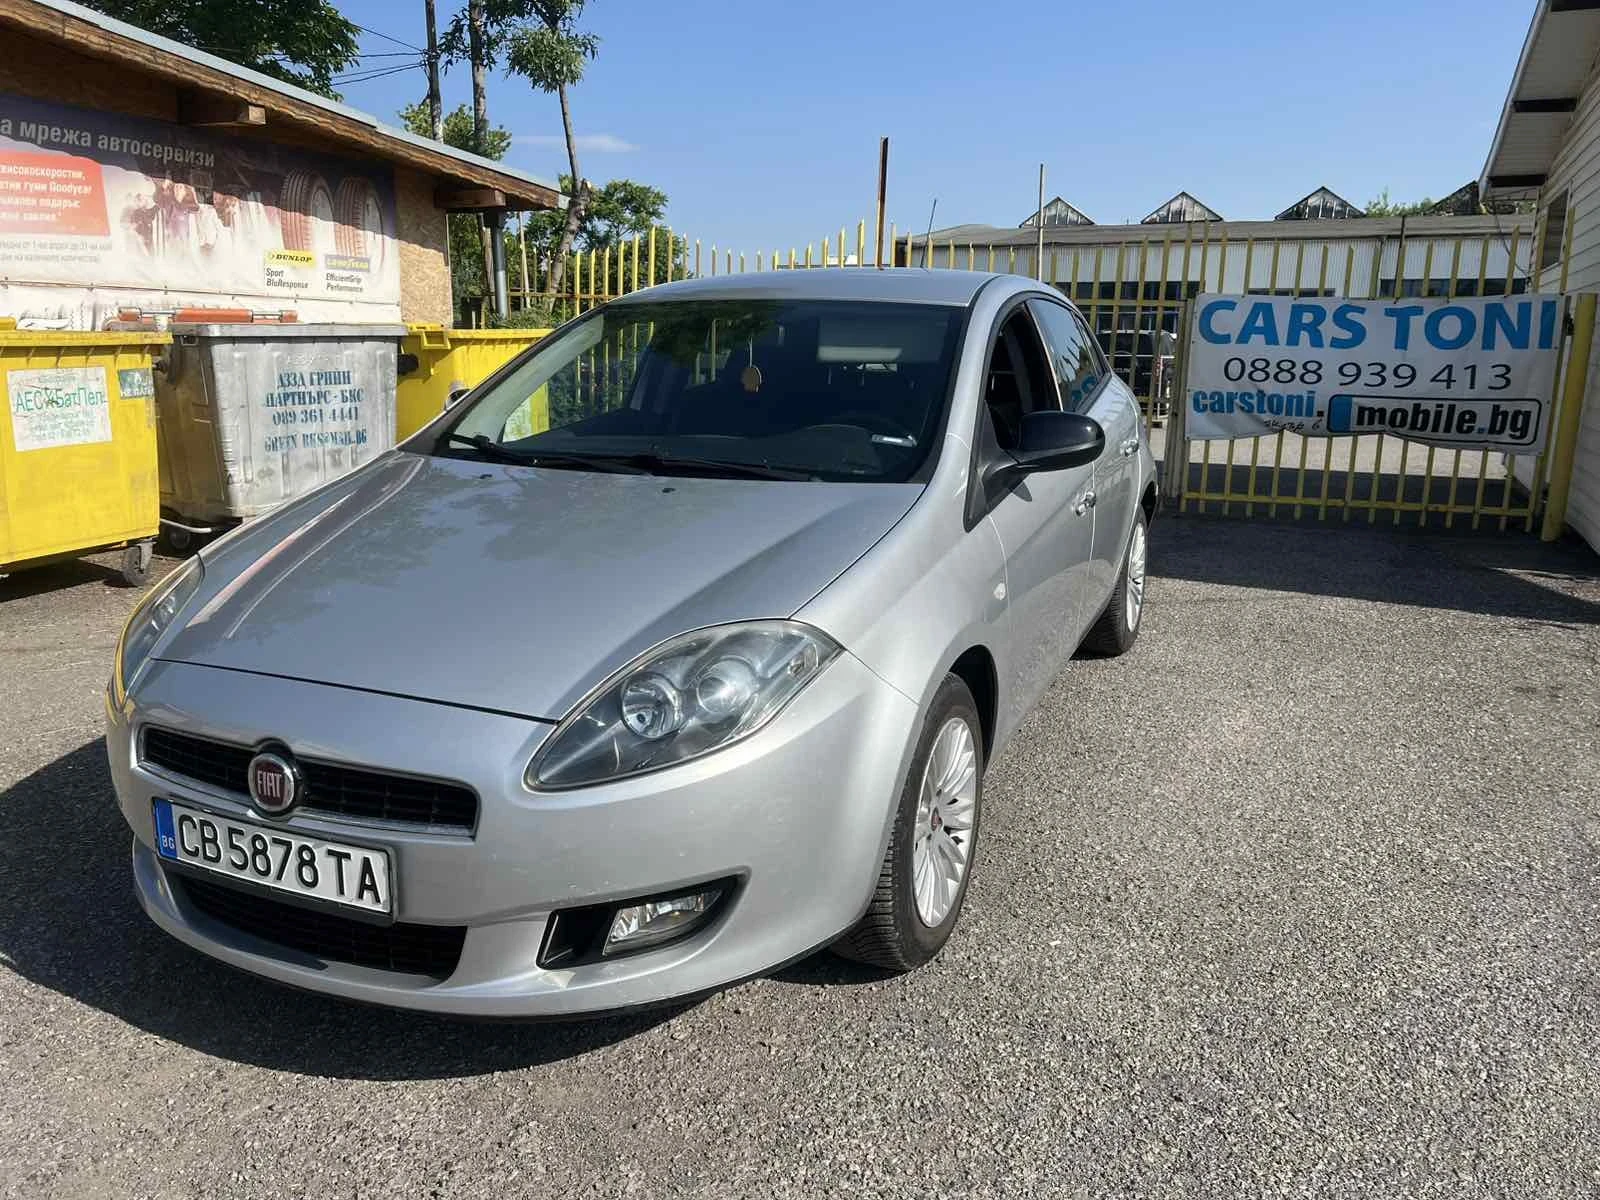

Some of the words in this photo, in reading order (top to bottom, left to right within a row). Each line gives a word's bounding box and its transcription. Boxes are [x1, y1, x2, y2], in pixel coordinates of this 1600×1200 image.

[19, 121, 92, 147] мрежа
[98, 134, 216, 167] автосервизи
[275, 253, 312, 262] DUNLOP
[266, 268, 284, 278] Sport
[1199, 299, 1367, 349] CARS
[1384, 300, 1557, 351] TONI
[1224, 356, 1324, 385] 0888
[1338, 361, 1418, 389] 939
[1430, 363, 1512, 390] 413
[300, 408, 323, 424] 361
[1355, 402, 1532, 440] mobile.bg
[257, 769, 282, 798] FIAT
[161, 834, 175, 850] BG
